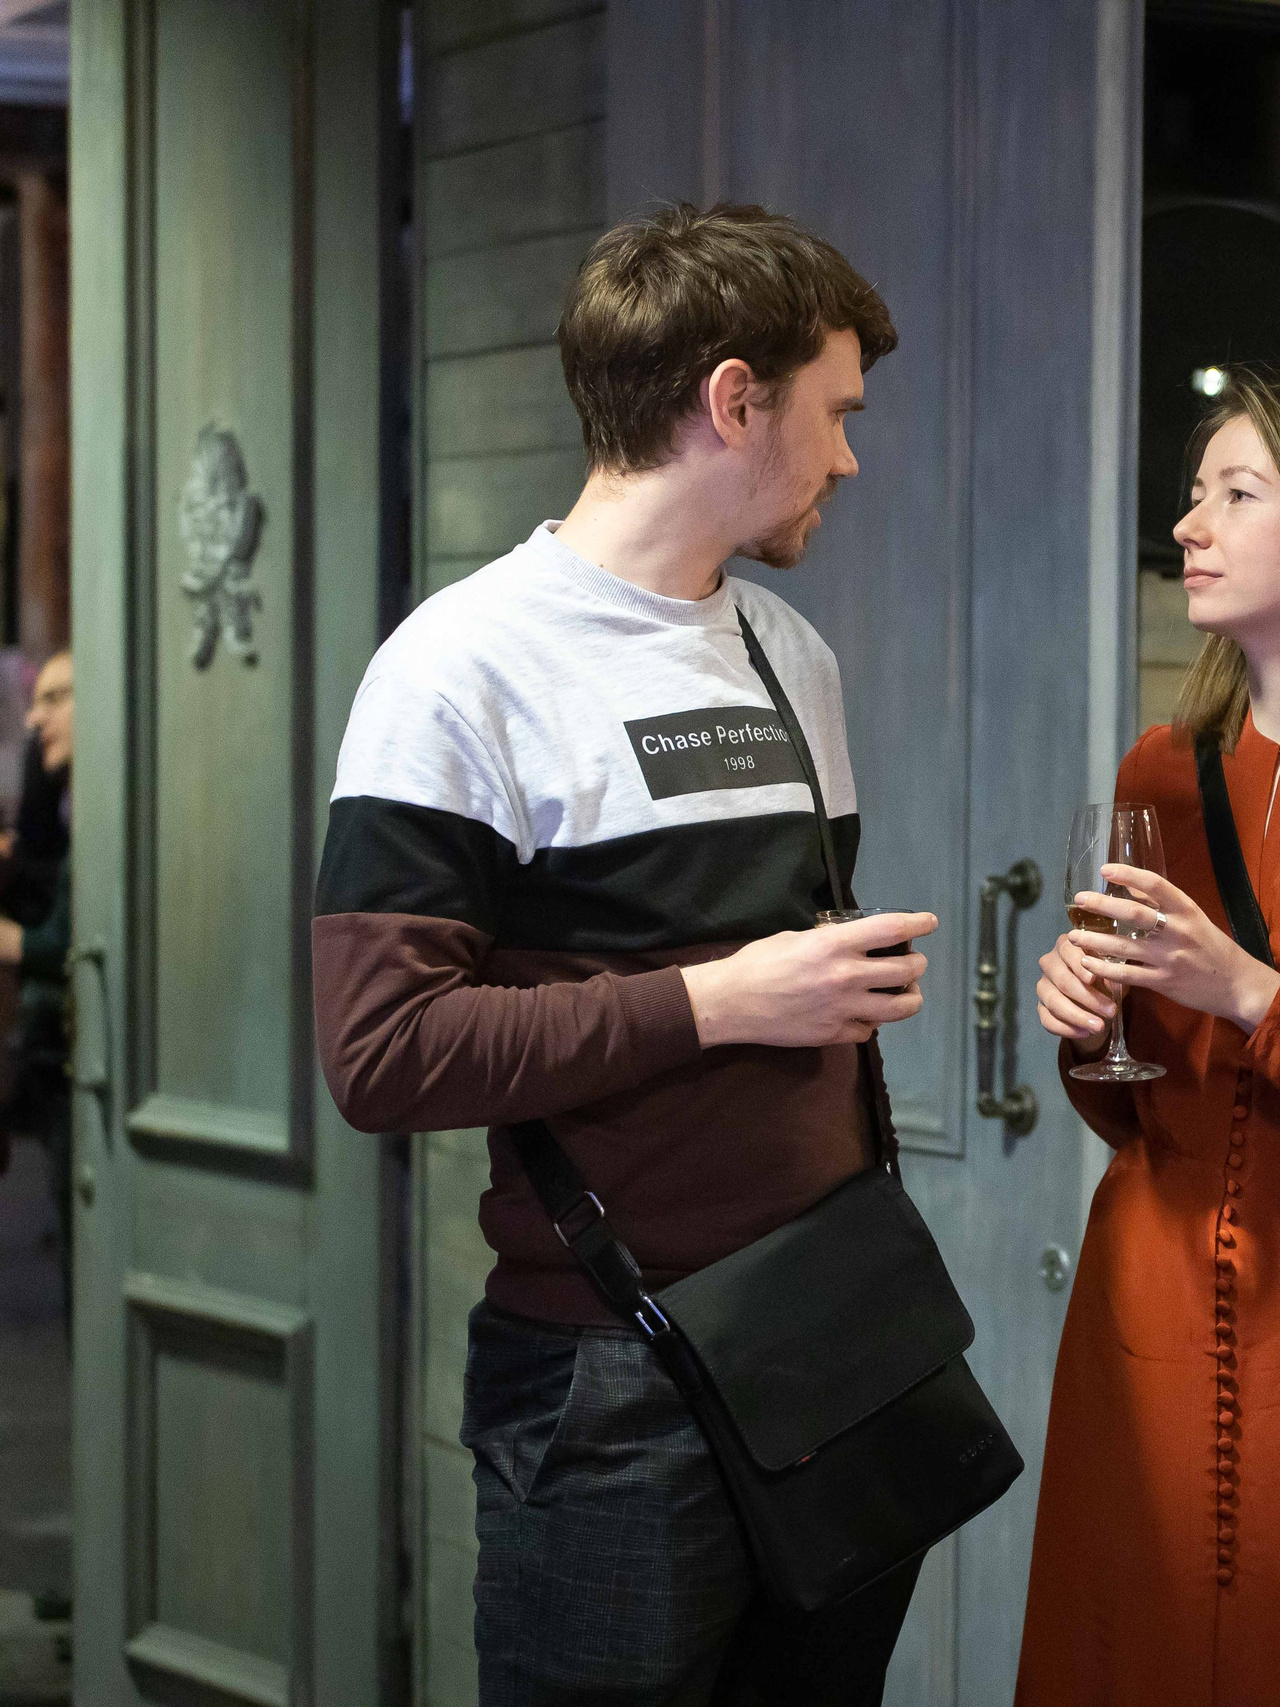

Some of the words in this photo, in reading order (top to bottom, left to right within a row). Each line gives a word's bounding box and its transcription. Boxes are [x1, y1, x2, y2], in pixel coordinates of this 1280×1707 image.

[641, 729, 712, 755] Chase
[715, 723, 791, 745] Perfectio
[724, 755, 756, 771] 1998
